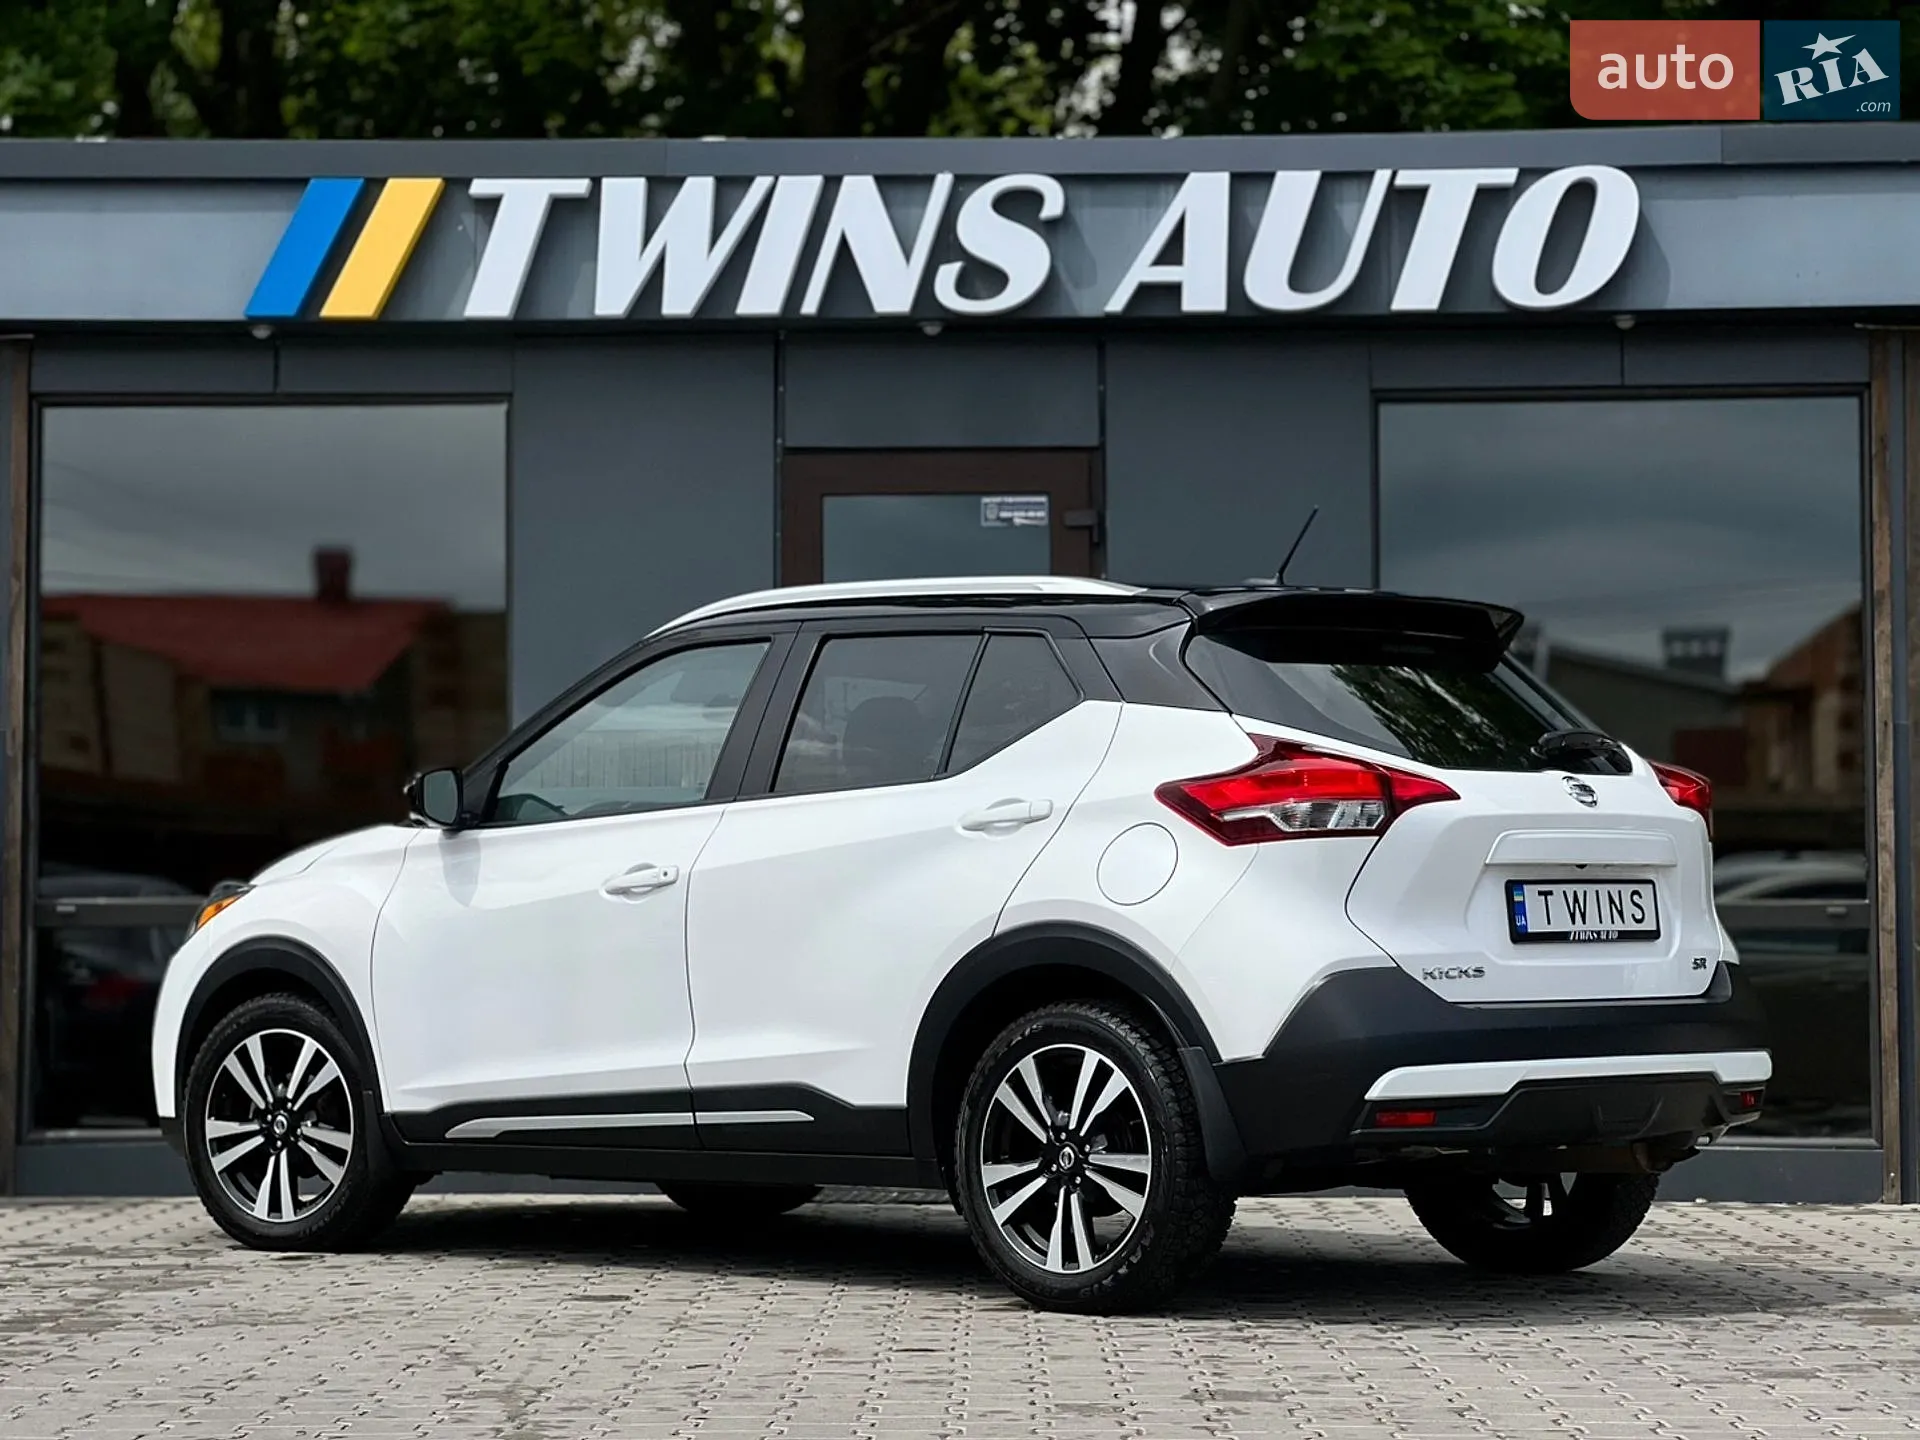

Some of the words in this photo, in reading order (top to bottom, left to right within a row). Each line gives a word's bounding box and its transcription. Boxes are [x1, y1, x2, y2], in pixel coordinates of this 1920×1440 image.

[464, 171, 1065, 319] TWINS
[1104, 164, 1641, 314] AUTO
[1537, 889, 1646, 926] TWINS
[1515, 915, 1527, 926] UA
[1691, 957, 1708, 970] SR
